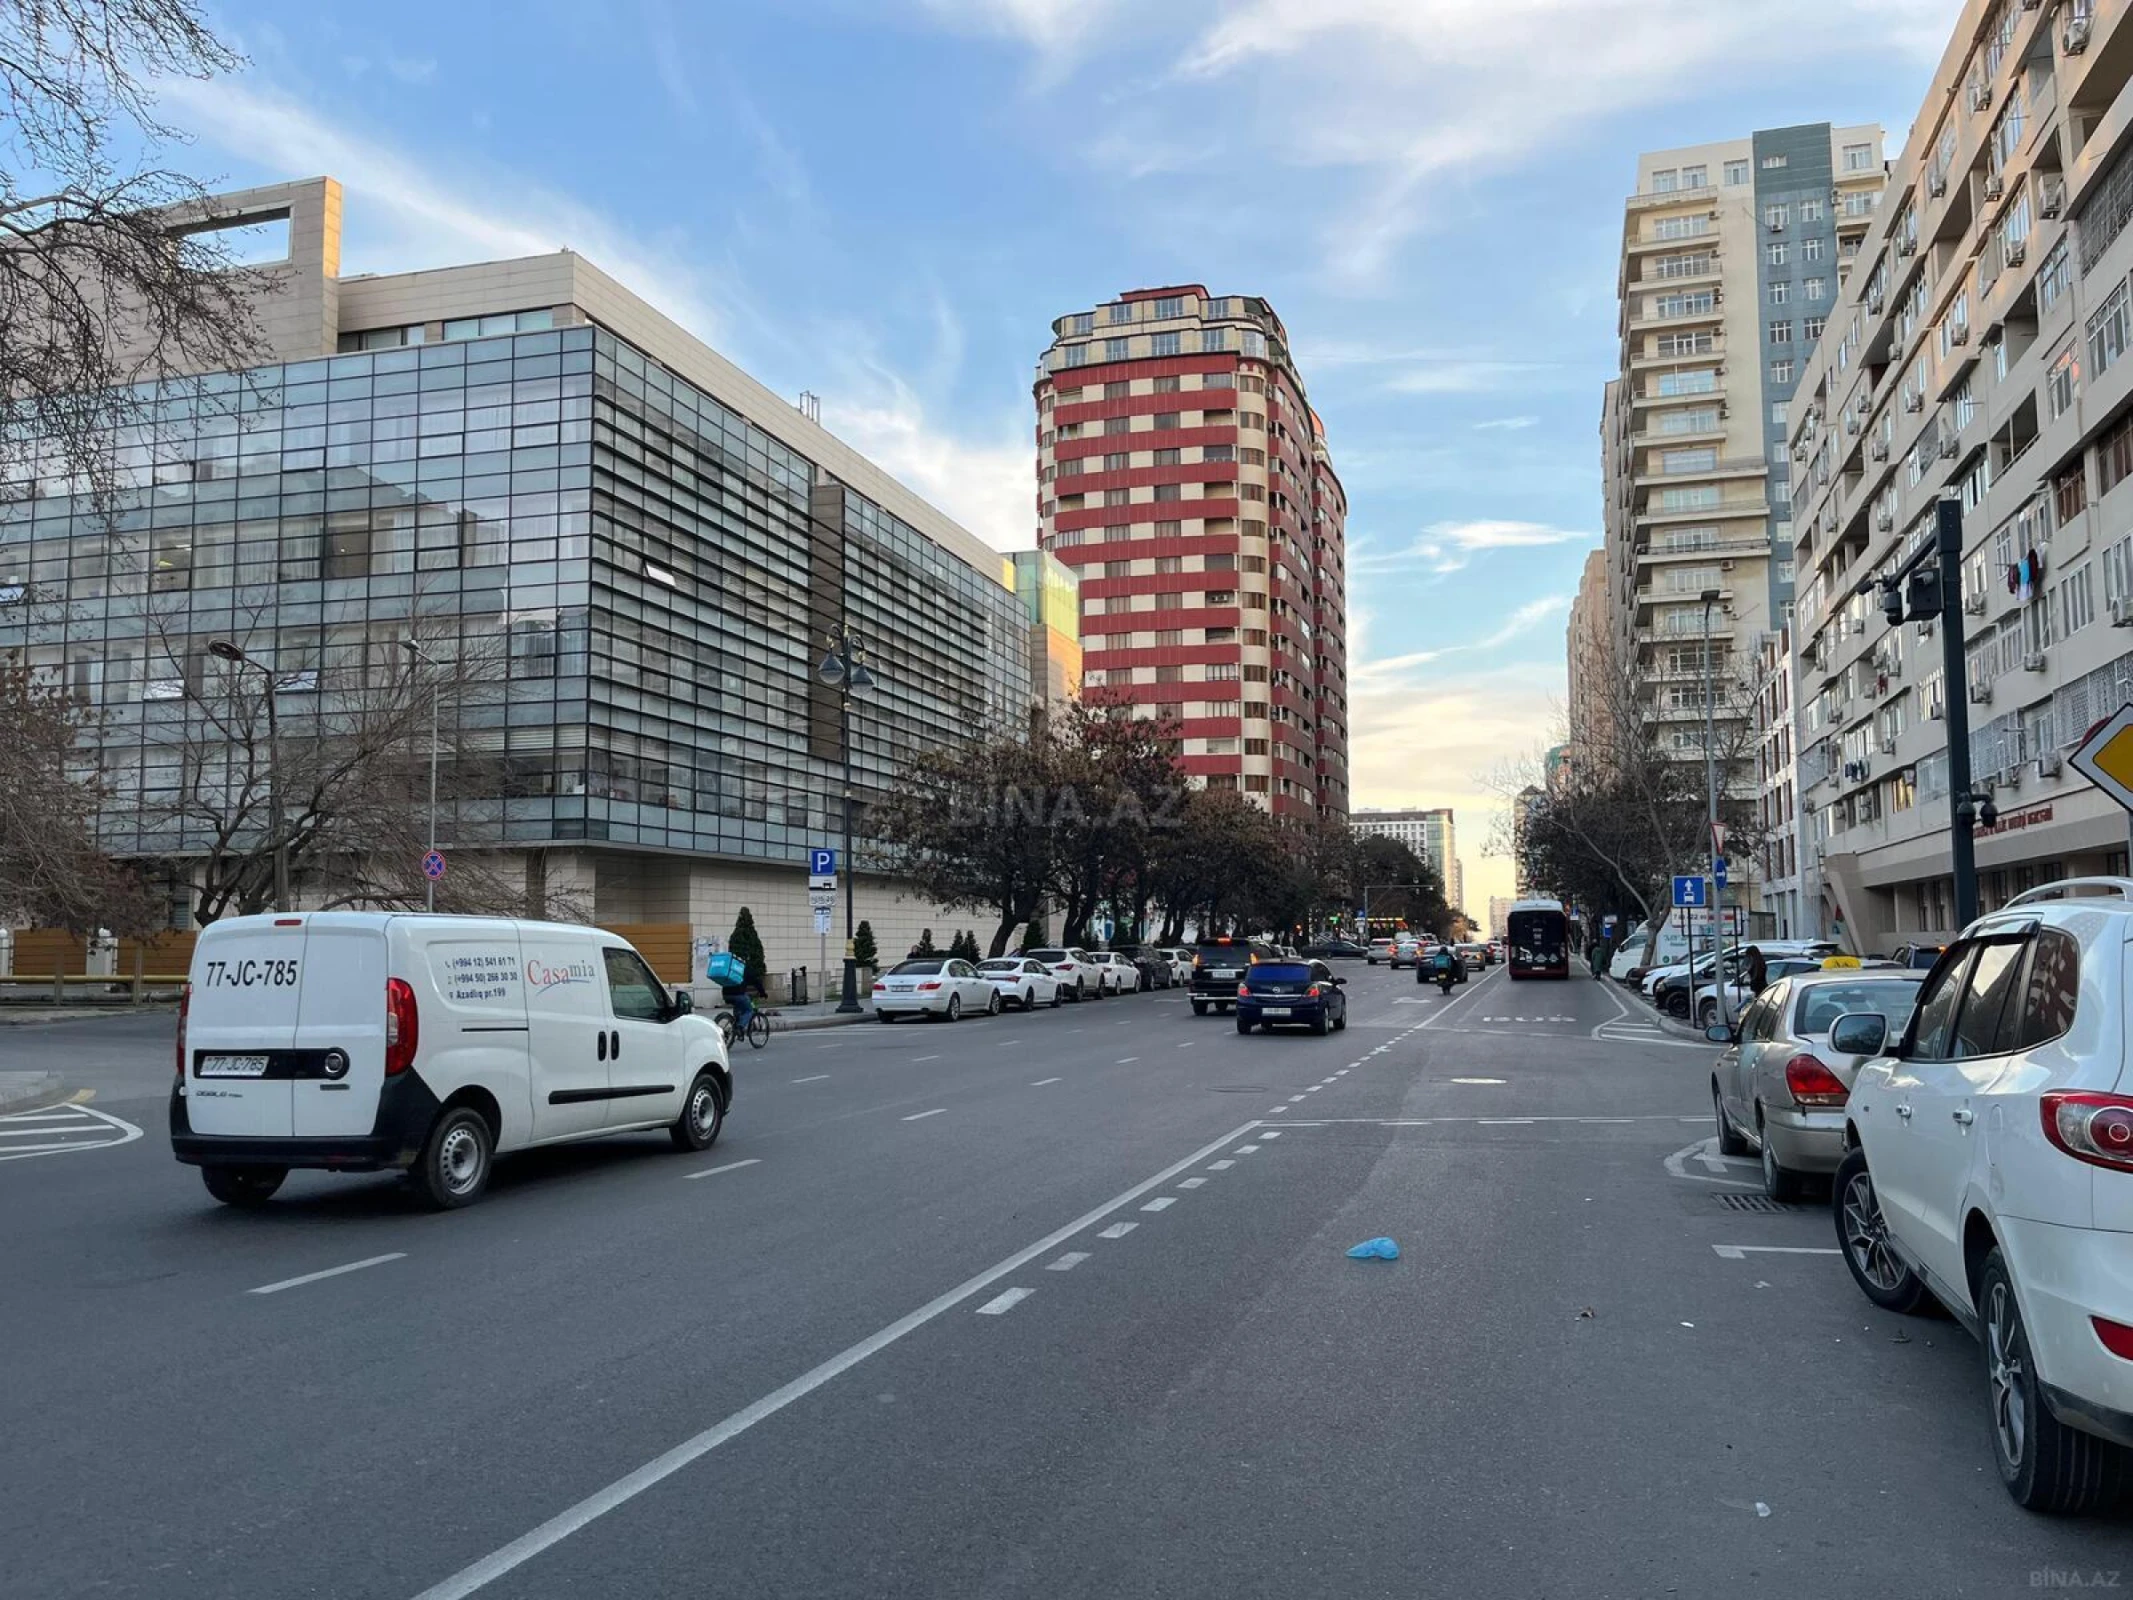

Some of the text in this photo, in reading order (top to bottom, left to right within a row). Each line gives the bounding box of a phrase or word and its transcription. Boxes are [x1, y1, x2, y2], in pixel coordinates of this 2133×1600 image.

[817, 852, 830, 872] P
[485, 956, 497, 966] 541
[507, 956, 516, 966] 71
[527, 959, 595, 985] Casamia
[206, 960, 298, 987] 77-JC-785
